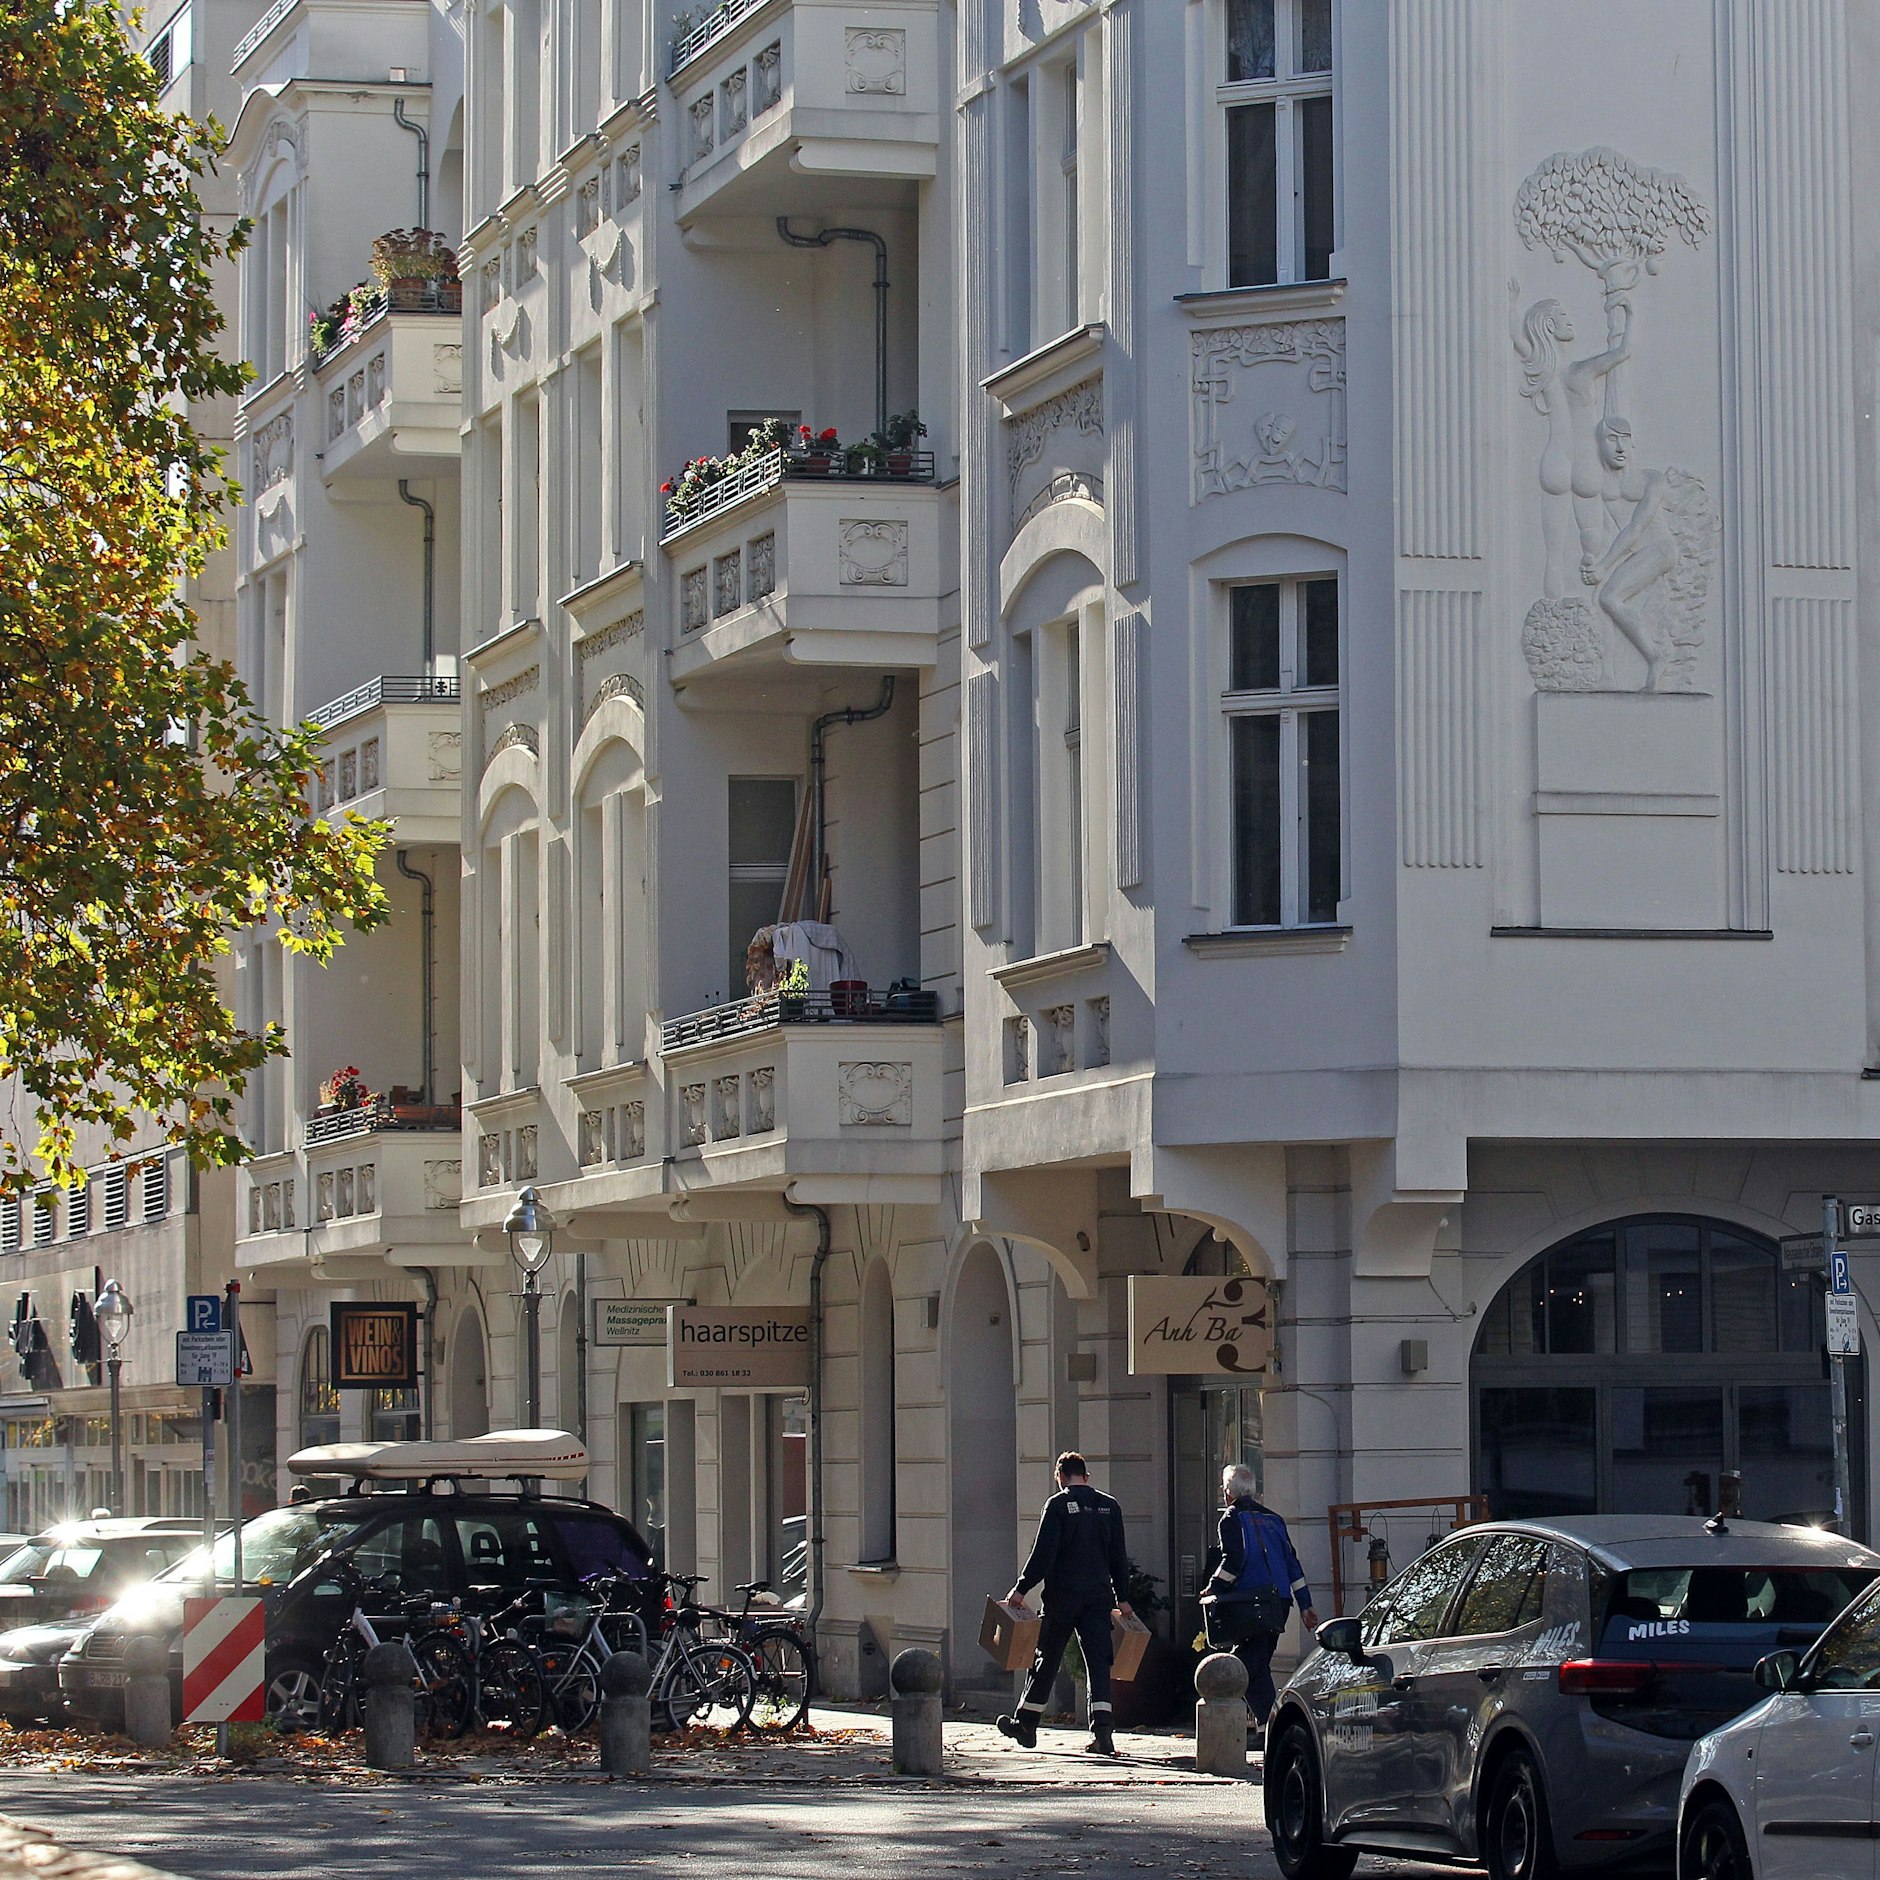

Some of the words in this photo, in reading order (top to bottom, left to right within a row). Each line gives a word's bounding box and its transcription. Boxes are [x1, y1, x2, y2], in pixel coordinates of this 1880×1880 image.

[1852, 1208, 1880, 1226] Gas
[1834, 1258, 1845, 1289] P
[194, 1300, 213, 1329] P
[606, 1305, 664, 1313] Medizinische
[606, 1327, 640, 1336] Wellnitz
[681, 1319, 808, 1347] haarspitze
[1204, 1317, 1243, 1342] Ba
[350, 1346, 401, 1373] VINOS
[1532, 1621, 1581, 1655] MILES
[1628, 1620, 1690, 1641] MILES
